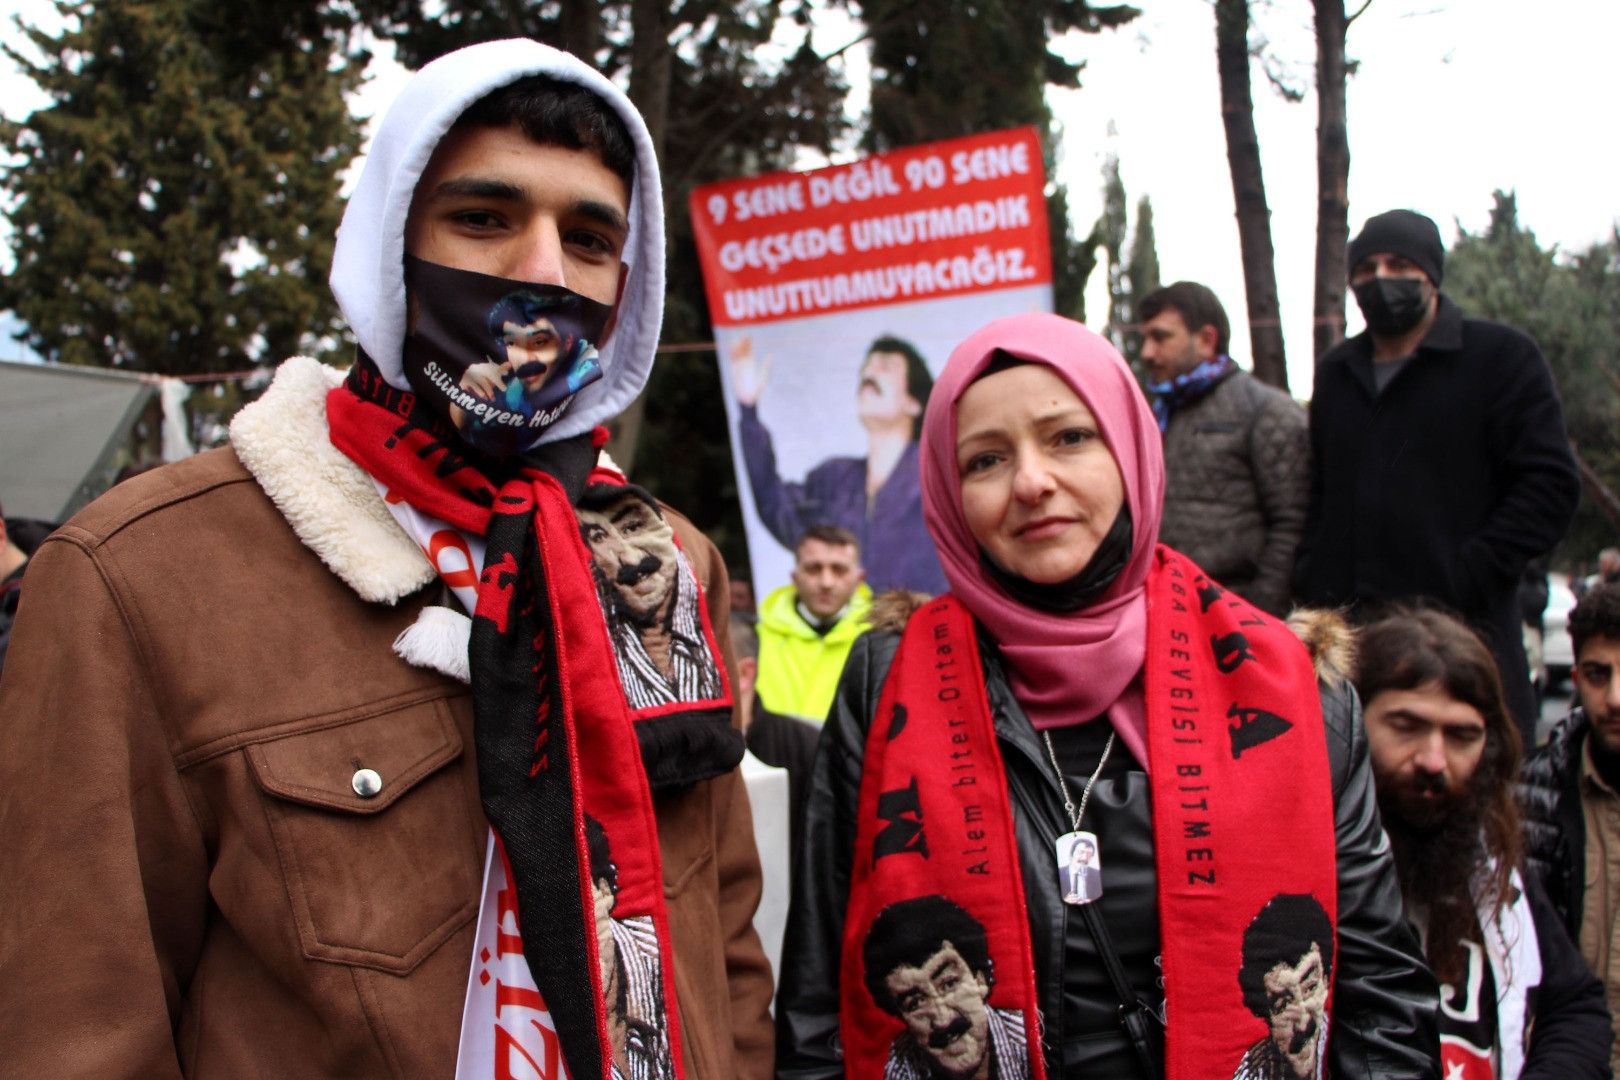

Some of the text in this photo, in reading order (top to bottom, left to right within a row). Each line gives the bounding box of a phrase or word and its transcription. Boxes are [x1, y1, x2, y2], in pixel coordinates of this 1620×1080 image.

[708, 142, 1029, 225] 9 SENE DEĞİL 90 SENE
[719, 195, 1031, 274] GEÇSEDE UNUTMADIK
[423, 361, 525, 427] Silinmeyen
[961, 803, 991, 876] Alem
